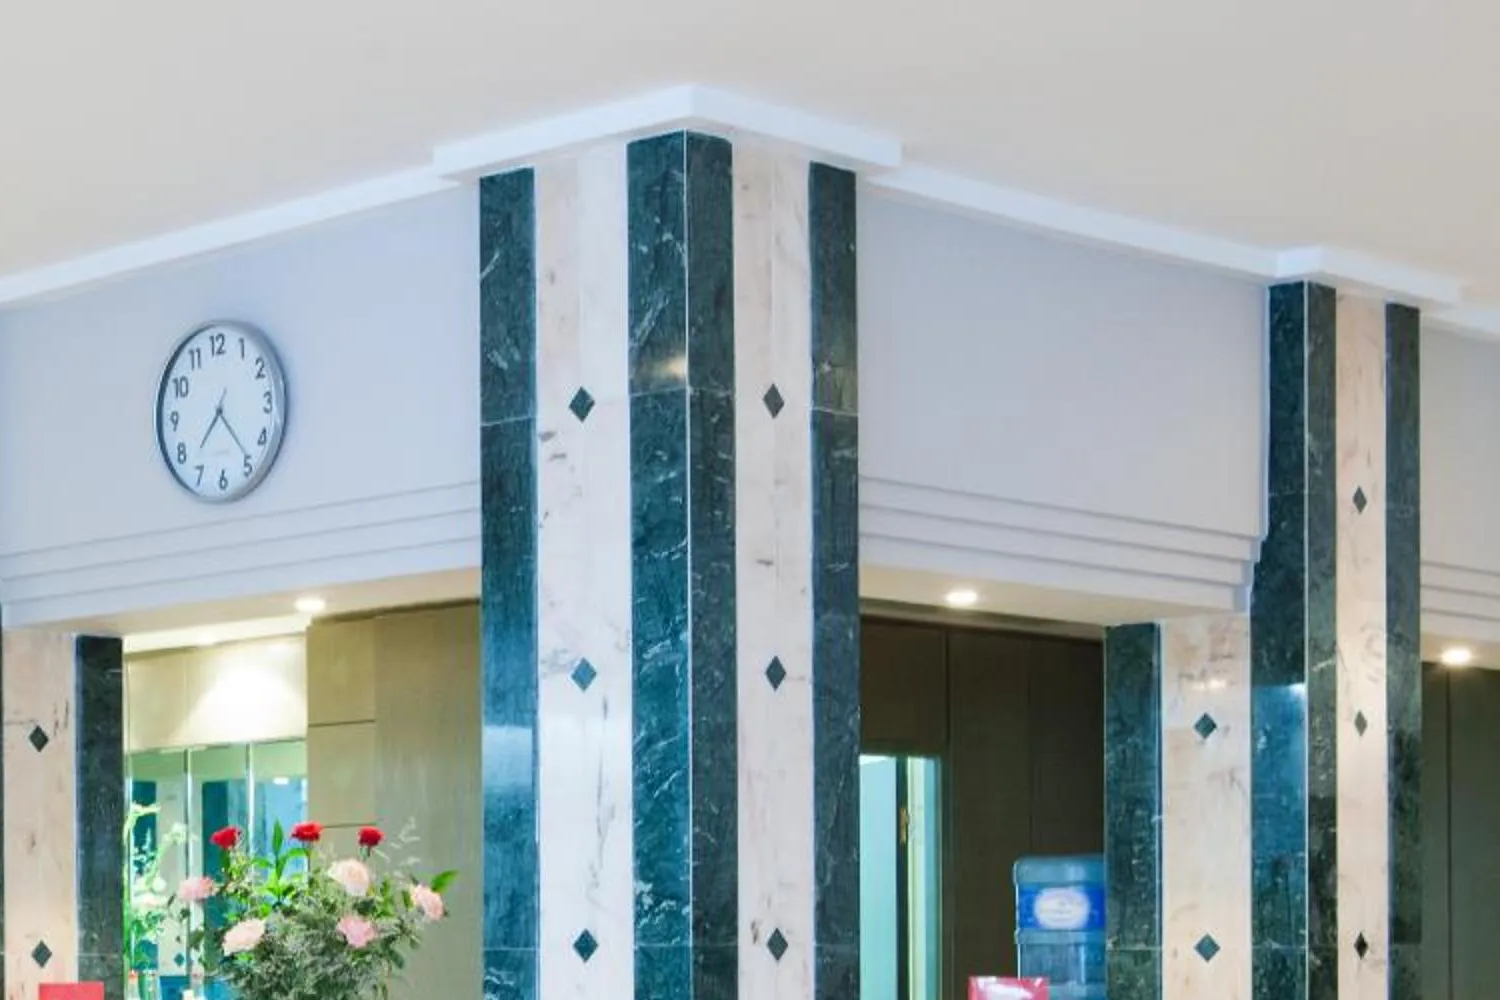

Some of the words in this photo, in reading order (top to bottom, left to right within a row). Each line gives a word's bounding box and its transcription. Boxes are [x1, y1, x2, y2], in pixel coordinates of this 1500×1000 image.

[209, 333, 225, 356] 12
[238, 337, 245, 359] 1
[188, 348, 202, 371] 11
[255, 357, 266, 379] 2
[172, 376, 189, 398] 10
[263, 391, 273, 414] 3
[170, 411, 179, 432] 9
[257, 427, 267, 446] 4
[177, 442, 187, 464] 8
[194, 465, 204, 486] 7
[243, 455, 253, 477] 5
[219, 469, 228, 490] 6
